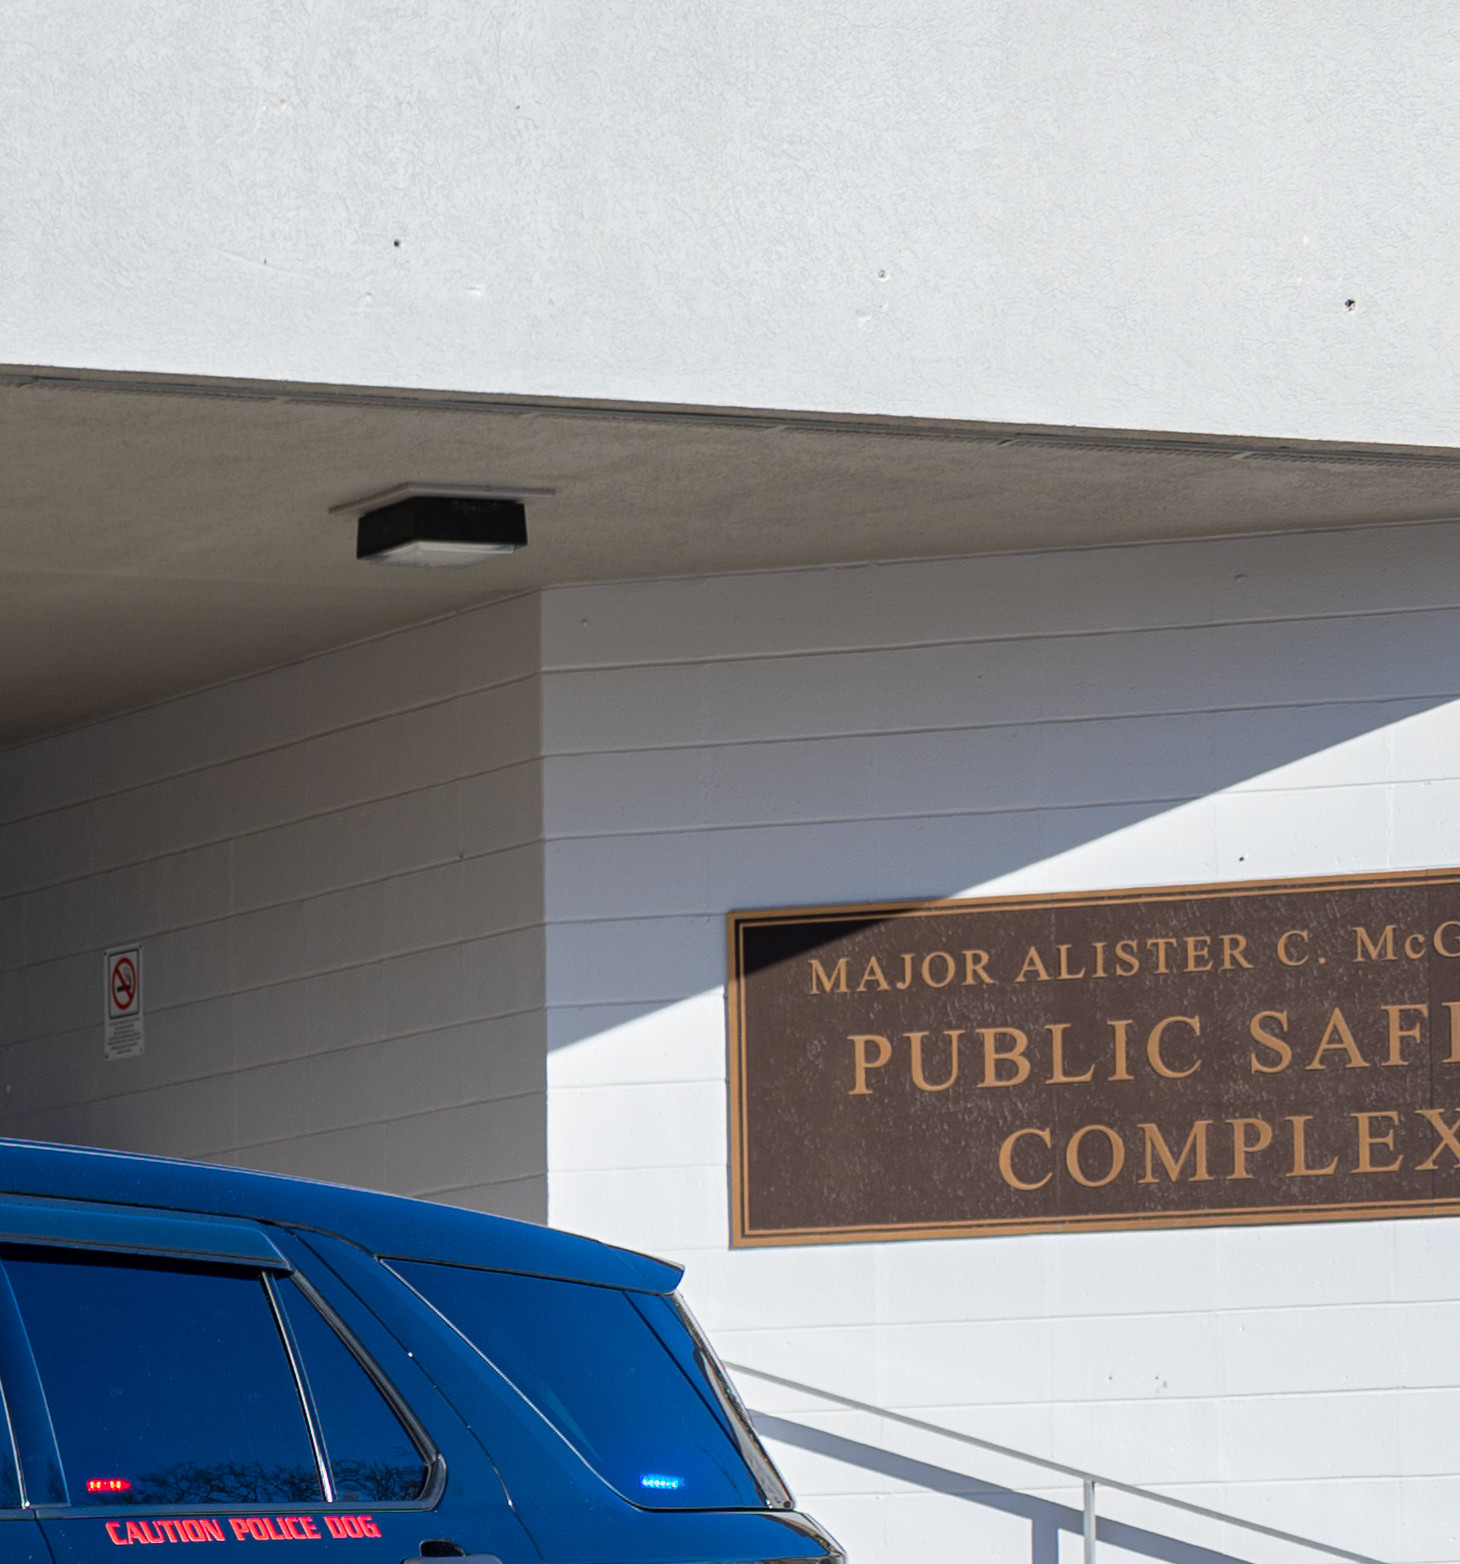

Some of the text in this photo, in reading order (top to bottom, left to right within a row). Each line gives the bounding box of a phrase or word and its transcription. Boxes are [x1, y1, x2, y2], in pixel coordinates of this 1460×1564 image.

[808, 949, 996, 995] MAJOR
[1014, 932, 1254, 982] ALISTER
[1276, 929, 1328, 967] C.
[846, 1013, 1203, 1096] PUBLIC
[998, 1107, 1460, 1191] COMPLEX
[105, 1515, 382, 1546] CAUTION POLICE DOG
